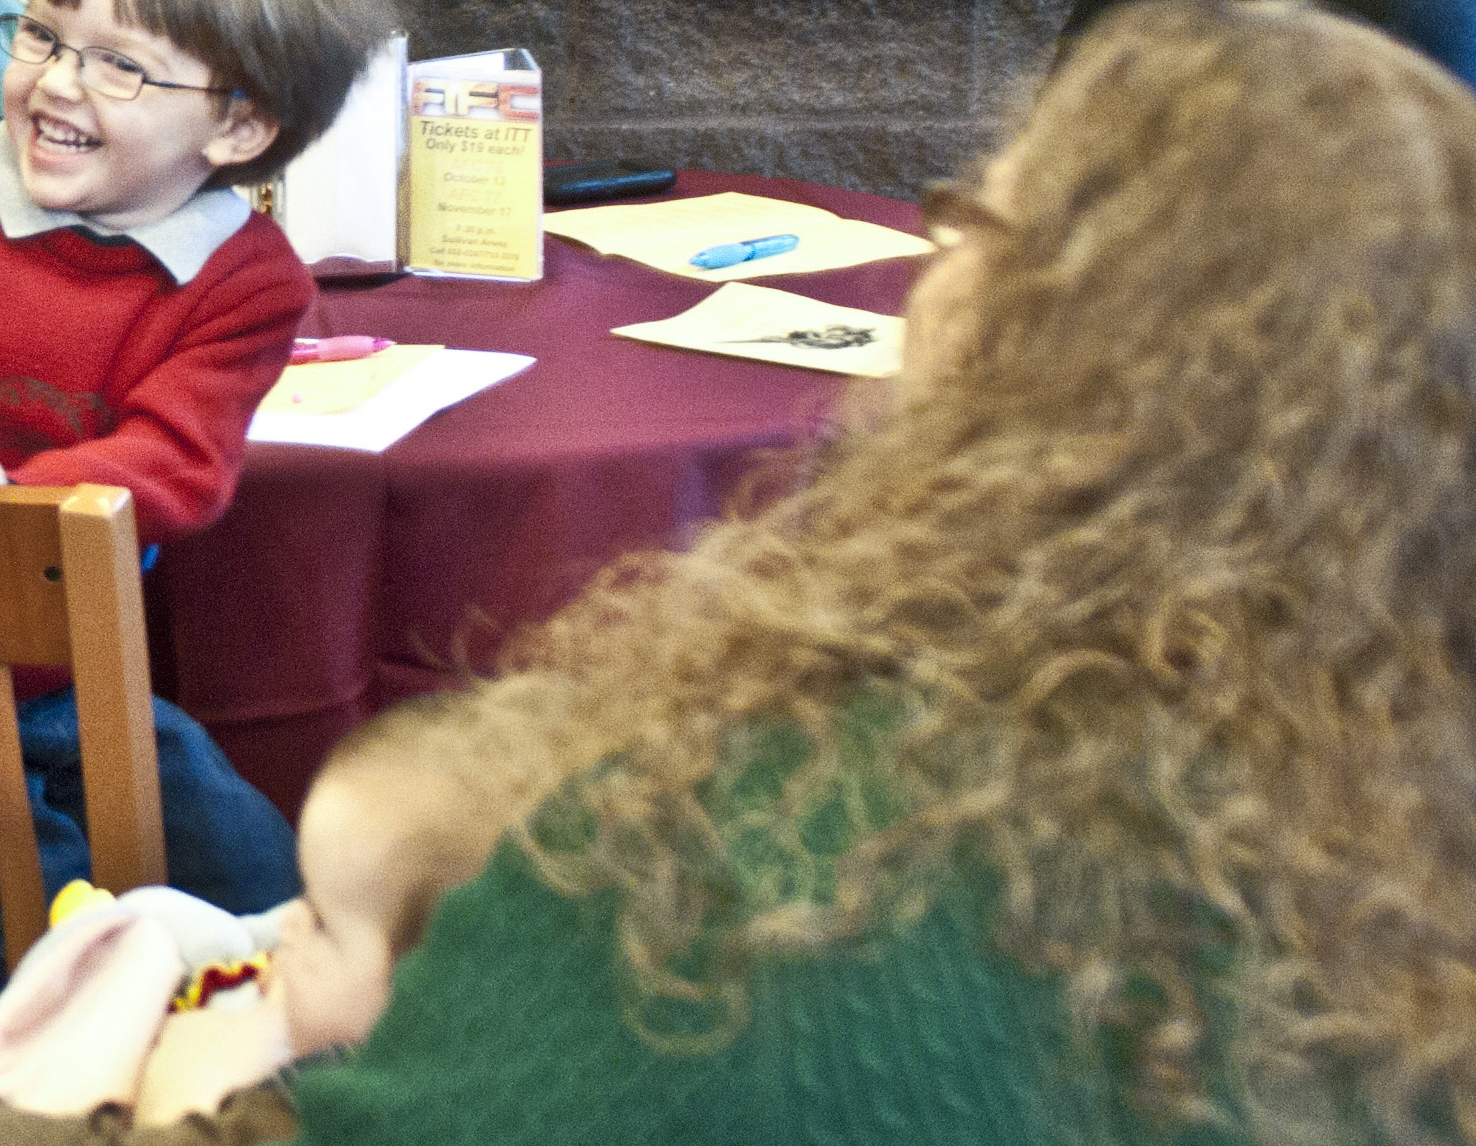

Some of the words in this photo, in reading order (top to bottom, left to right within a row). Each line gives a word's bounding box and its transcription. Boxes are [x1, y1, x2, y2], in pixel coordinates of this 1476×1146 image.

[420, 120, 479, 139] Tickets
[484, 128, 501, 141] at
[504, 127, 533, 143] ITT
[425, 137, 457, 153] Only
[461, 140, 484, 153] $19
[443, 171, 489, 184] October
[437, 201, 496, 215] November
